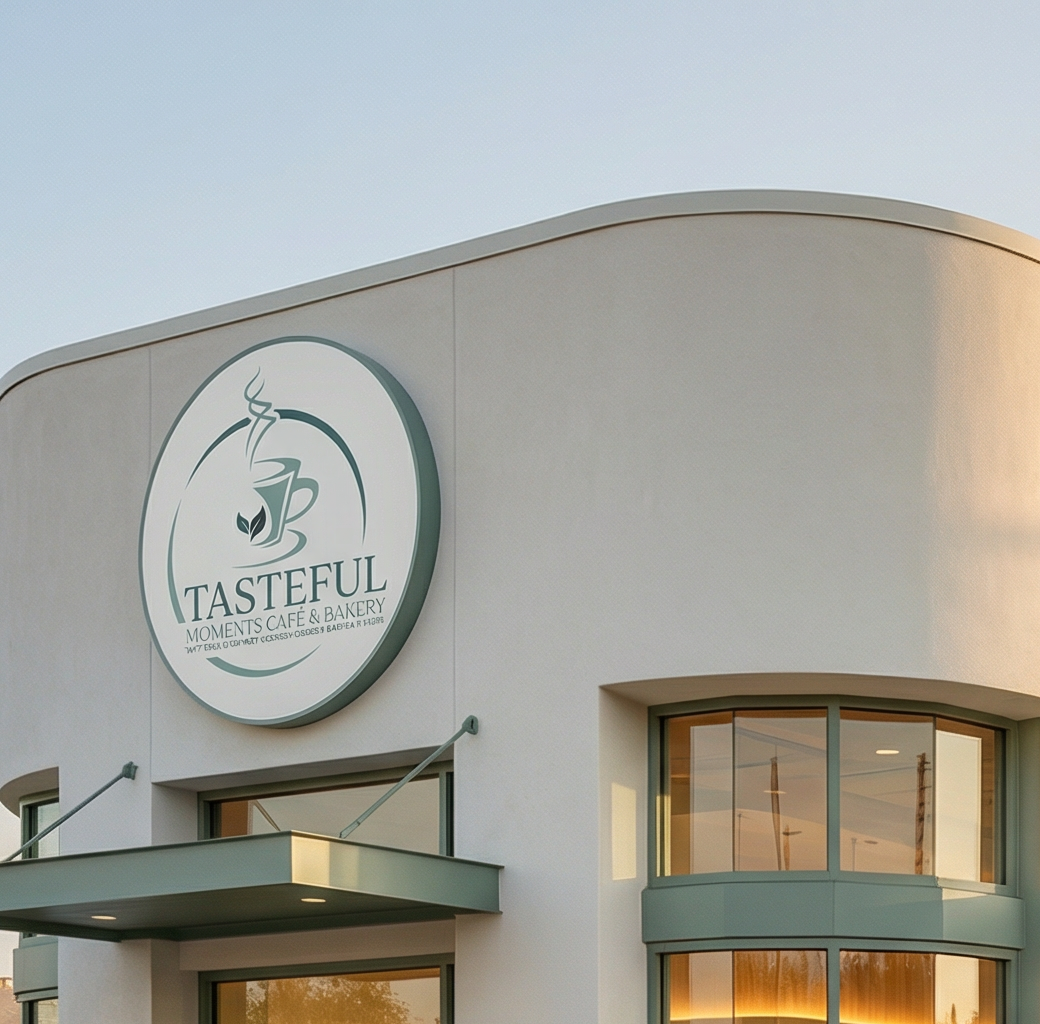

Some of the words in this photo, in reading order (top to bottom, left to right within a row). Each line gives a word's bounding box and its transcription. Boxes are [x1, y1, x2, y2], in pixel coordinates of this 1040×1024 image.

[183, 555, 388, 622] TASTEFUL
[186, 617, 263, 644] MOMENTS
[266, 606, 306, 631] CAFÉ
[309, 608, 320, 624] &
[324, 597, 386, 623] BAKERY
